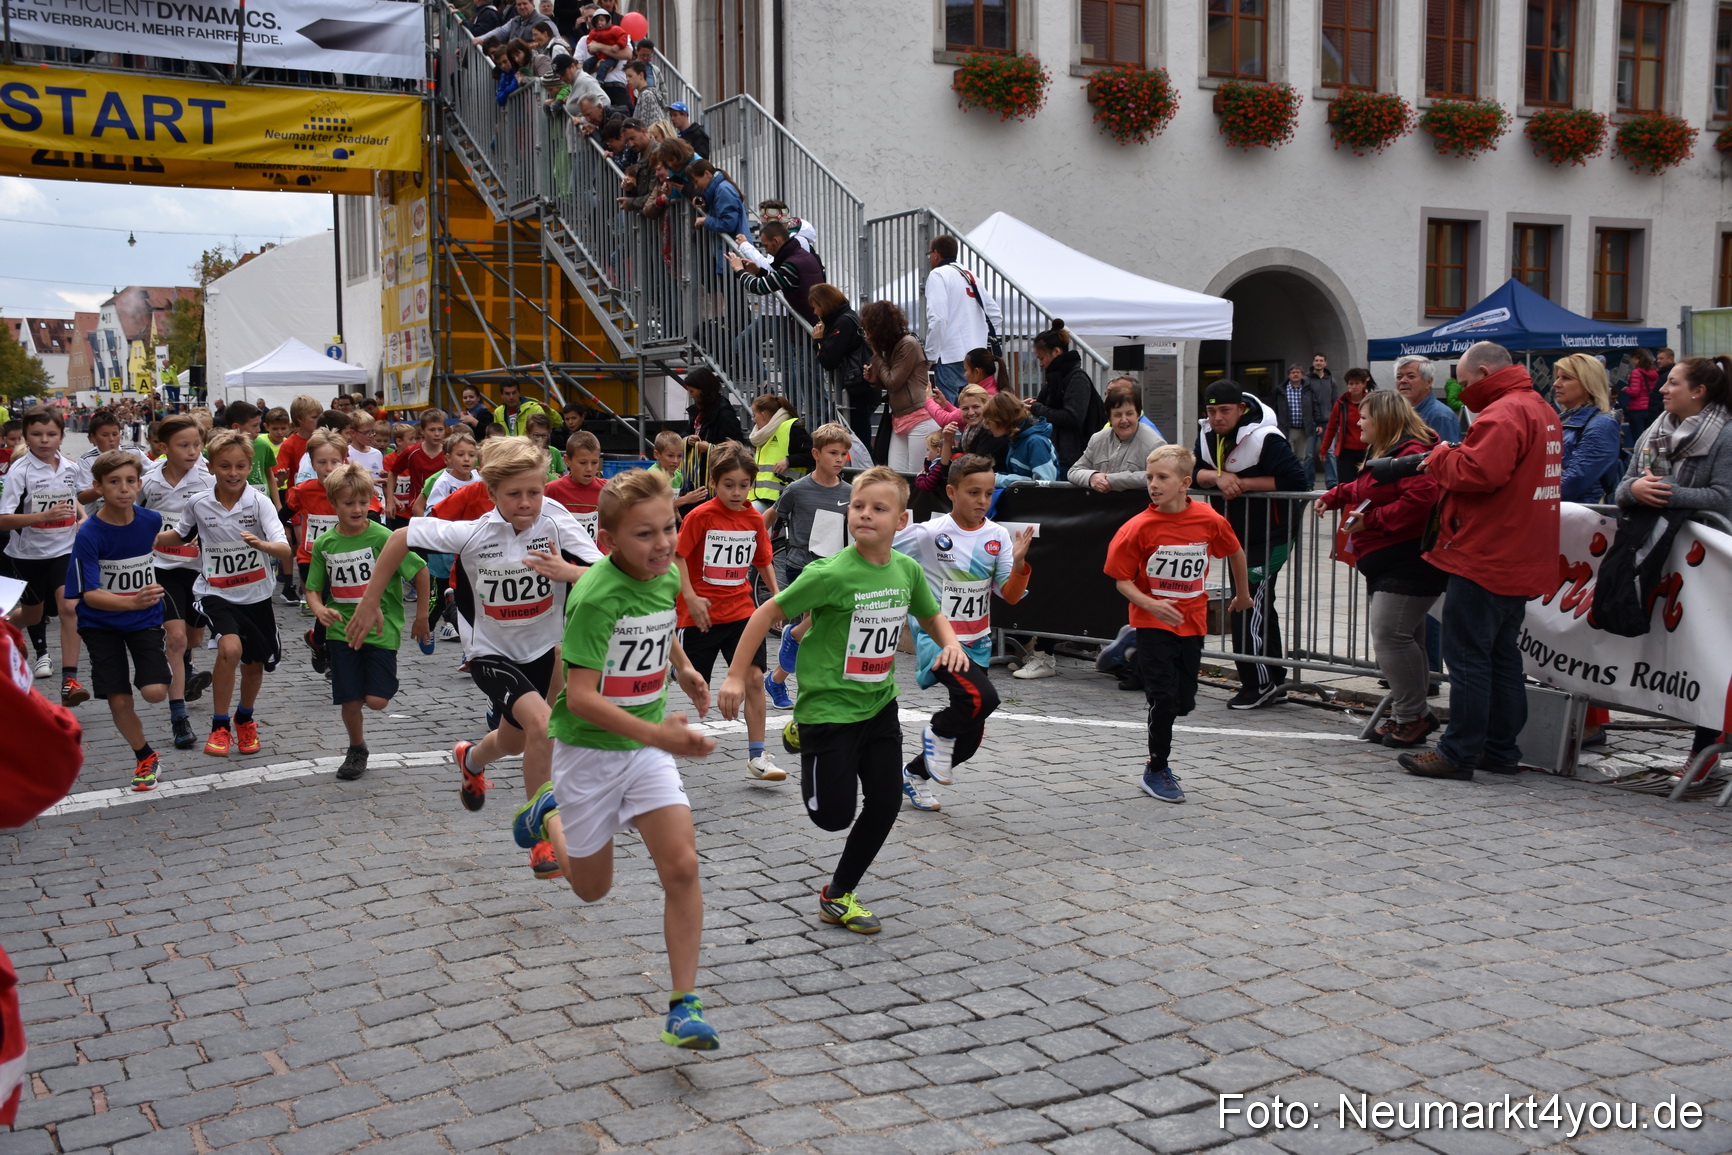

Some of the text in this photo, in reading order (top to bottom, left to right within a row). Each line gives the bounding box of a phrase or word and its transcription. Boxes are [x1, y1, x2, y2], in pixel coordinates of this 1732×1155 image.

[41, 10, 139, 33] VERBRAUCH.
[142, 22, 185, 37] MEHR
[0, 82, 226, 144] START
[264, 129, 389, 146] Neumarkter Stadtlauf
[1561, 333, 1639, 348] Neumarkter Tagblatt
[1400, 342, 1450, 355] Neumarkter
[113, 382, 120, 391] B
[140, 379, 149, 390] A
[334, 556, 363, 564] Neumarkt
[479, 551, 503, 559] Vincent
[712, 544, 752, 565] 7161
[211, 550, 260, 575] 7022
[1155, 558, 1205, 579] 7169
[104, 567, 152, 590] 7006
[479, 568, 502, 577] PARTL
[226, 576, 249, 586] Lukas
[484, 575, 551, 603] 7028
[854, 588, 900, 602] Neumarkter
[944, 586, 967, 594] PARTL
[500, 606, 539, 618] Vincent
[853, 616, 879, 625] PARTL
[612, 626, 644, 636] PARTL
[1630, 662, 1700, 702] Radio
